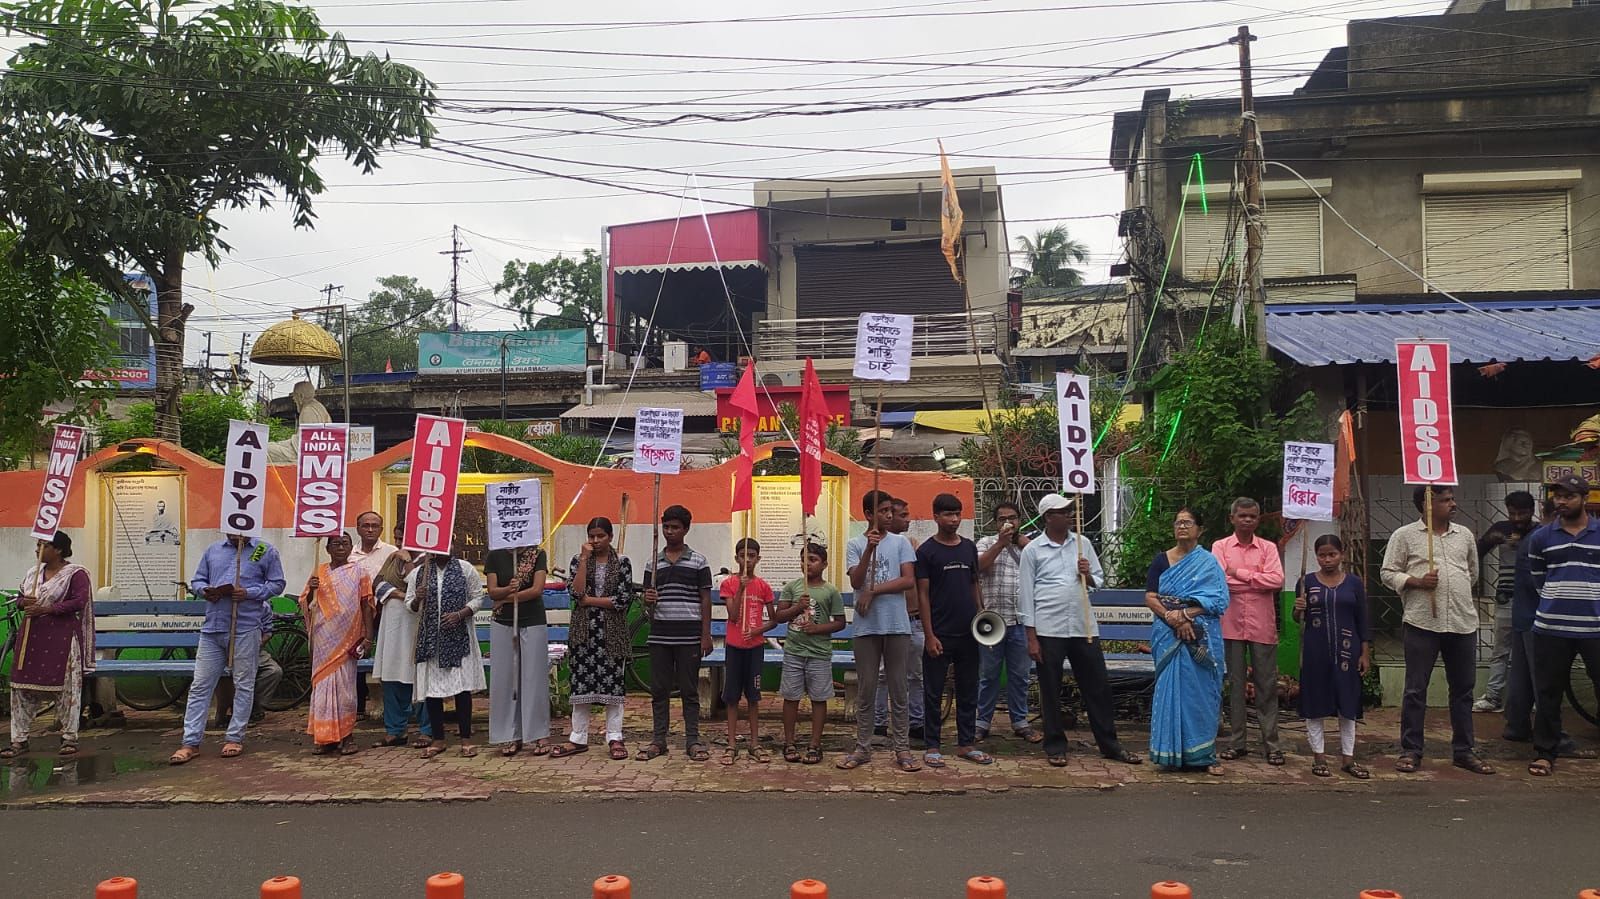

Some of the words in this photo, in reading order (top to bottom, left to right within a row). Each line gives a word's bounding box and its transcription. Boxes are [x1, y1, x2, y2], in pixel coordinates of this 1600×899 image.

[868, 360, 897, 375] চাই
[1410, 345, 1442, 481] AIDSO
[60, 430, 76, 439] ALL
[310, 431, 336, 441] ALL
[1064, 381, 1089, 489] AIDYO
[55, 439, 77, 450] INDIA
[304, 441, 341, 452] INDIA
[227, 430, 262, 531] AIDYO
[416, 420, 450, 548] AIDSO
[36, 452, 75, 530] MSS
[299, 455, 342, 534] MSS
[499, 483, 521, 495] নারীর
[500, 520, 529, 530] করতে
[502, 530, 528, 543] হবে
[128, 621, 158, 629] PURULIA
